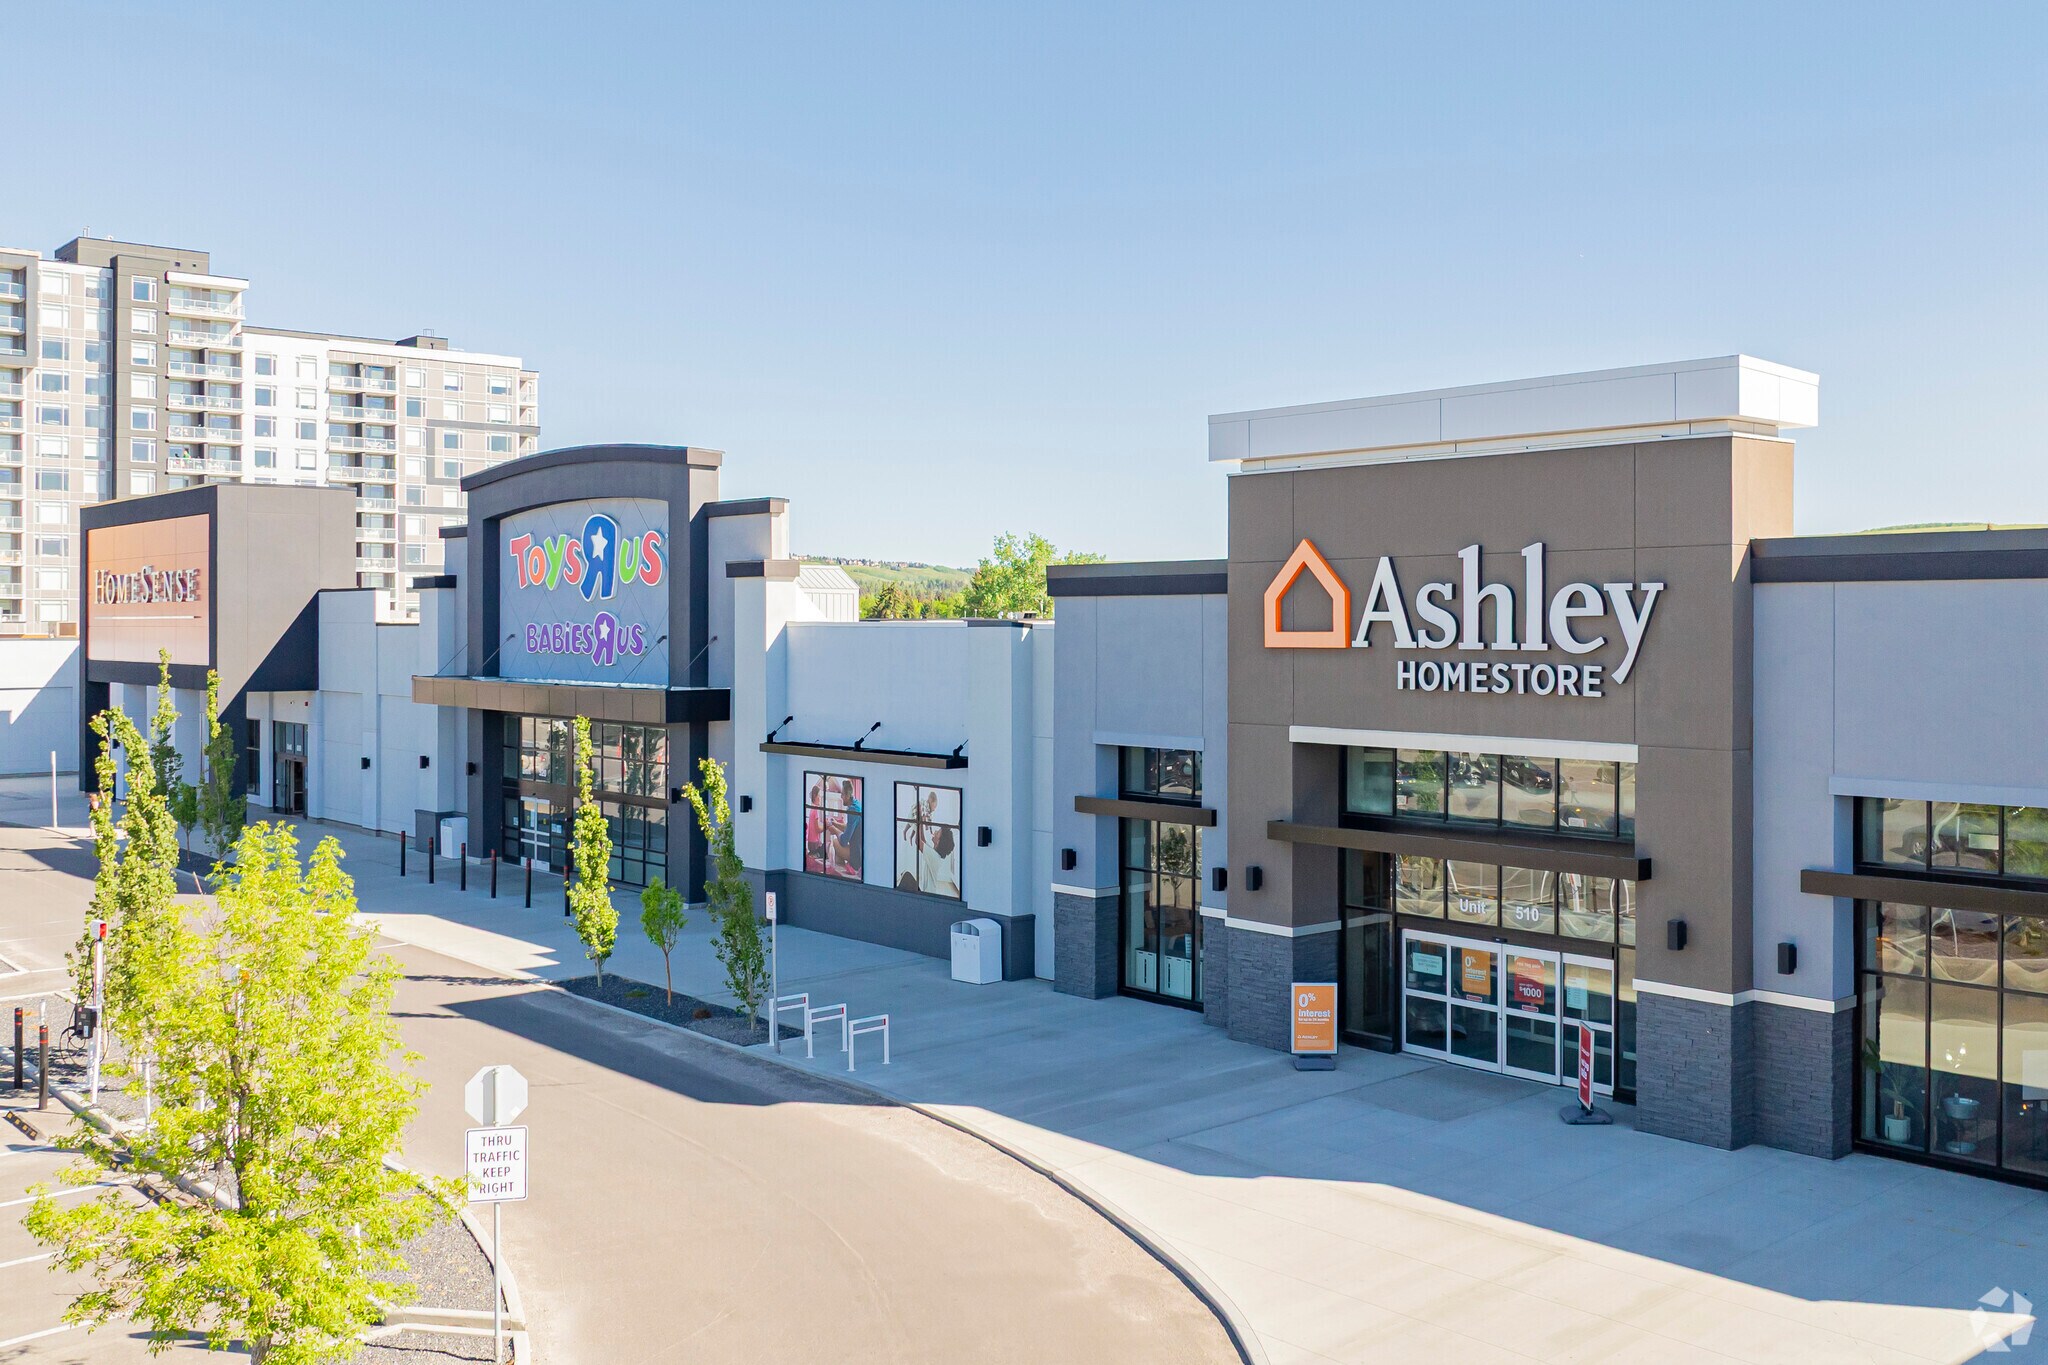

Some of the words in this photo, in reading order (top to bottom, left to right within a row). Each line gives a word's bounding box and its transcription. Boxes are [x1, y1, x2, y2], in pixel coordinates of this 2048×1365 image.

[94, 565, 197, 605] HOMESENSE
[1351, 542, 1664, 684] Ashley
[1397, 661, 1604, 697] HOMESTORE
[1459, 898, 1487, 914] Unit
[1515, 906, 1540, 921] 510
[1518, 986, 1542, 998] $1000
[1298, 993, 1316, 1008] 0%
[1298, 1009, 1331, 1018] interest
[481, 1135, 512, 1147] THRU
[473, 1150, 520, 1163] TRAFFIC
[483, 1166, 511, 1178] KEEP
[479, 1181, 514, 1194] RIGHT
